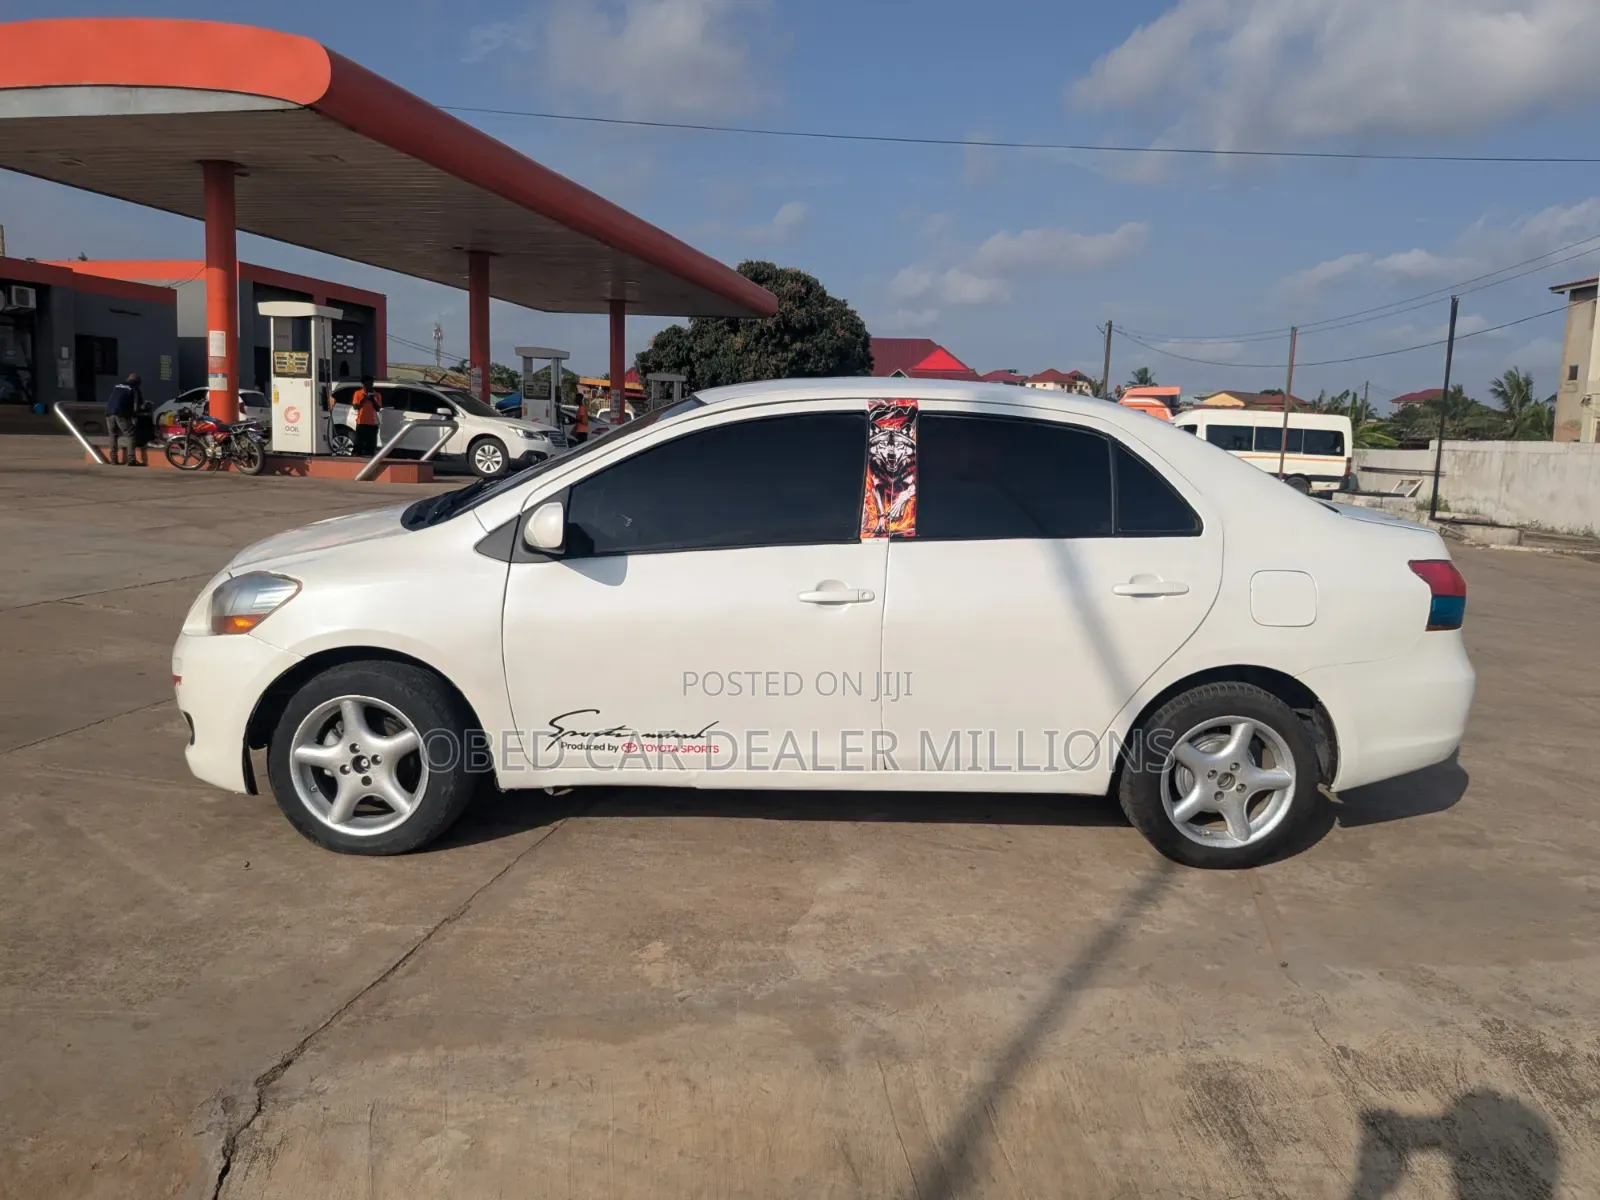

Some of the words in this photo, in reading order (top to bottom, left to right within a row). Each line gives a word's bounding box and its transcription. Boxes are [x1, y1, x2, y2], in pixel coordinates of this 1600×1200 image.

[560, 741, 606, 751] Produced
[607, 742, 619, 753] by
[641, 744, 679, 753] TOYOTA
[680, 745, 720, 754] SPORTS
